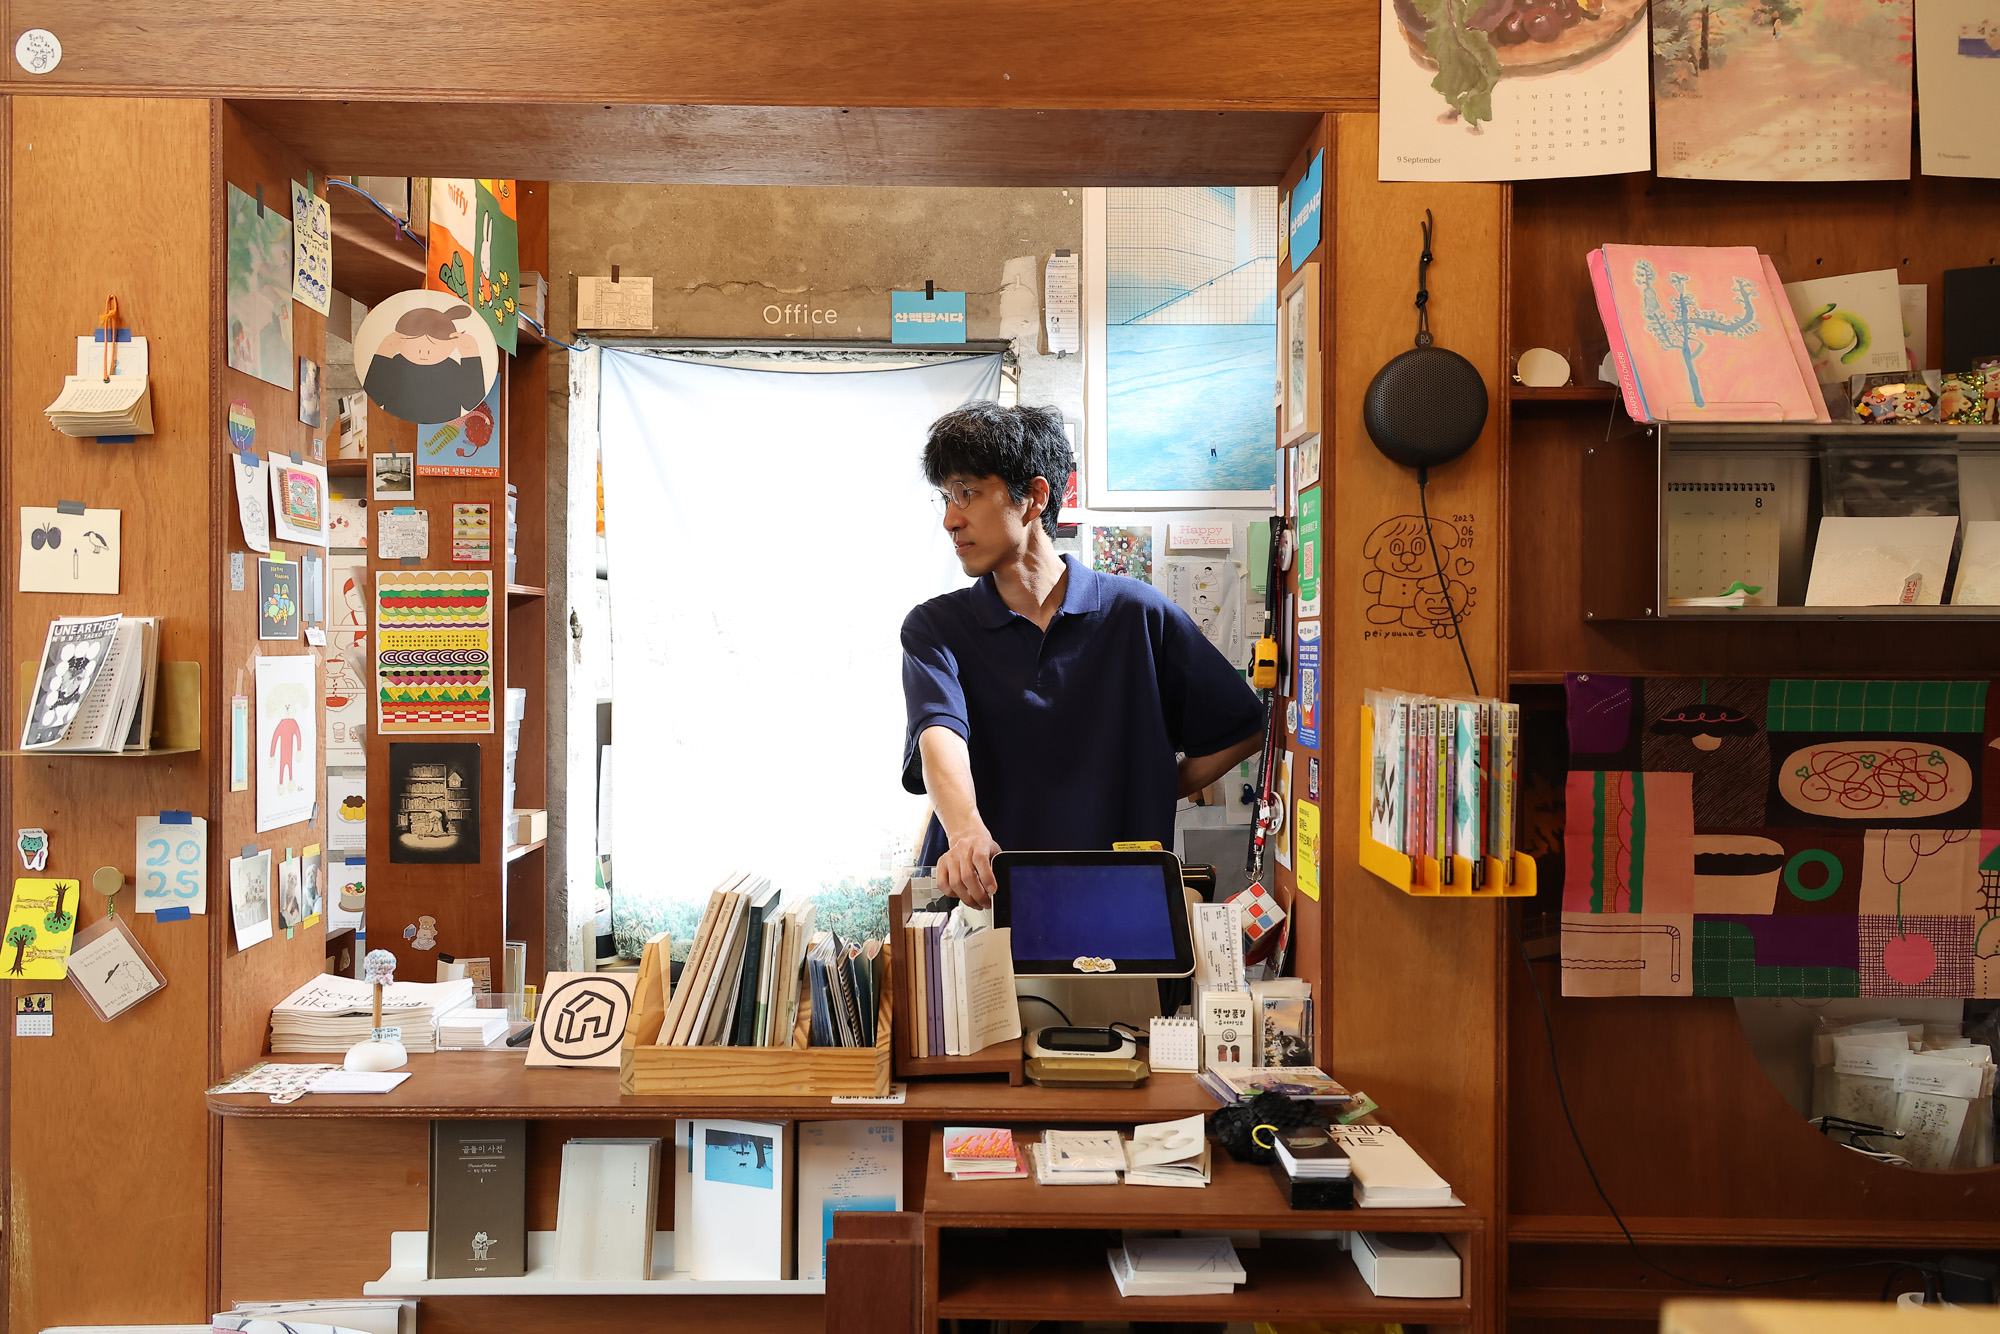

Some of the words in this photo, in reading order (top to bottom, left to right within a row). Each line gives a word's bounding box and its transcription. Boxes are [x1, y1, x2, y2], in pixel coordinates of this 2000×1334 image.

[1396, 155, 1402, 163] 9
[1403, 155, 1442, 165] September
[447, 183, 469, 216] miffy
[763, 305, 838, 325] Office
[893, 312, 964, 324] 산책합시다
[1617, 352, 1631, 380] FLOWERS
[1625, 382, 1633, 390] OF
[1627, 391, 1640, 415] SHAPES
[418, 466, 450, 475] 강아지처럼
[452, 468, 473, 476] 행복한
[474, 468, 480, 476] 건
[481, 469, 498, 477] 누구?
[1755, 497, 1763, 508] 8
[1452, 514, 1475, 522] 2023
[1179, 525, 1223, 536] Happy
[1461, 525, 1474, 536] 06
[1172, 536, 1200, 545] New
[1201, 536, 1231, 545] Year
[1460, 538, 1474, 548] 07
[54, 620, 117, 636] UNEARTHED
[83, 632, 103, 640] TAEKO
[146, 838, 201, 866] 20
[144, 869, 200, 899] 25
[693, 934, 704, 951] Handle
[708, 934, 719, 951] Handle
[690, 950, 699, 962] with
[705, 950, 713, 962] with
[686, 961, 695, 973] Care
[701, 961, 709, 973] Care
[308, 987, 407, 1002] Readng
[293, 996, 337, 1009] like
[462, 1145, 485, 1154] 곰돌이
[488, 1144, 503, 1154] 사전
